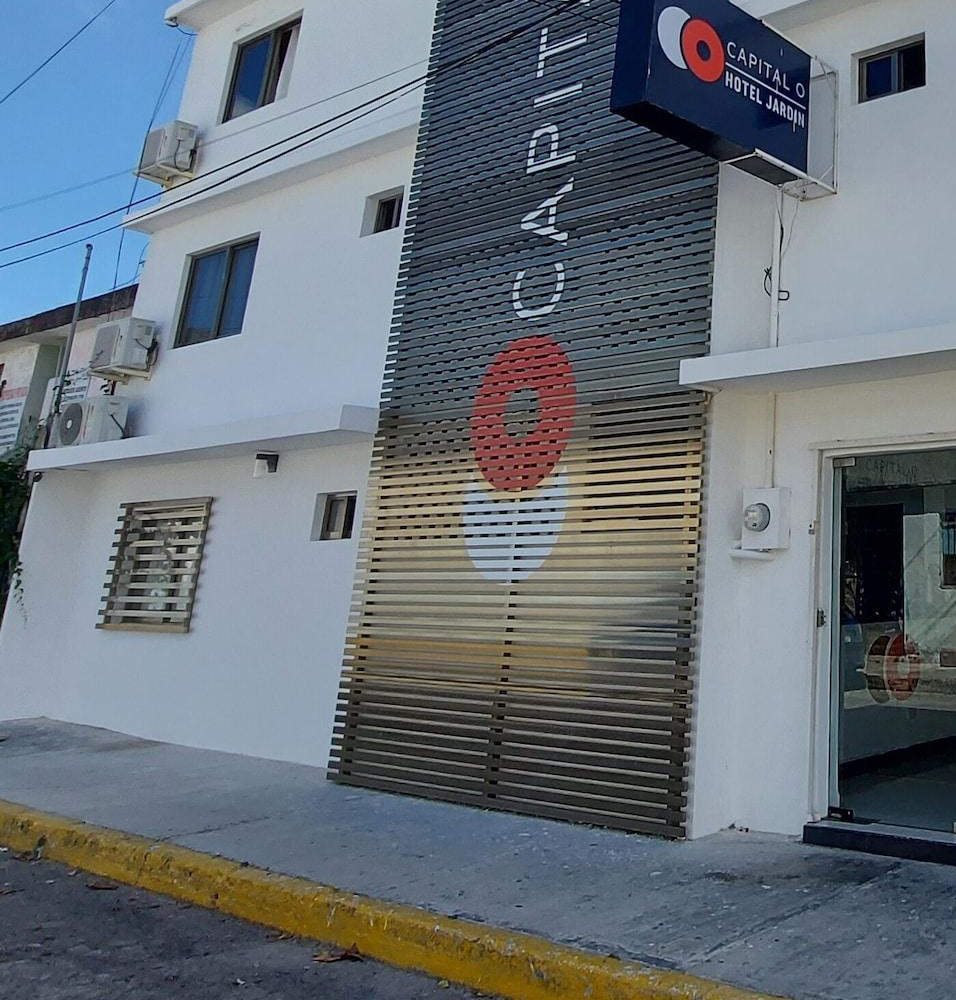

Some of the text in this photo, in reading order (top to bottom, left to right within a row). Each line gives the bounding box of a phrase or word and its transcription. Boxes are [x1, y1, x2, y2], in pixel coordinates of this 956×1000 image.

[727, 42, 805, 98] CAPITAL O
[725, 71, 805, 128] HOTEL JARDIN
